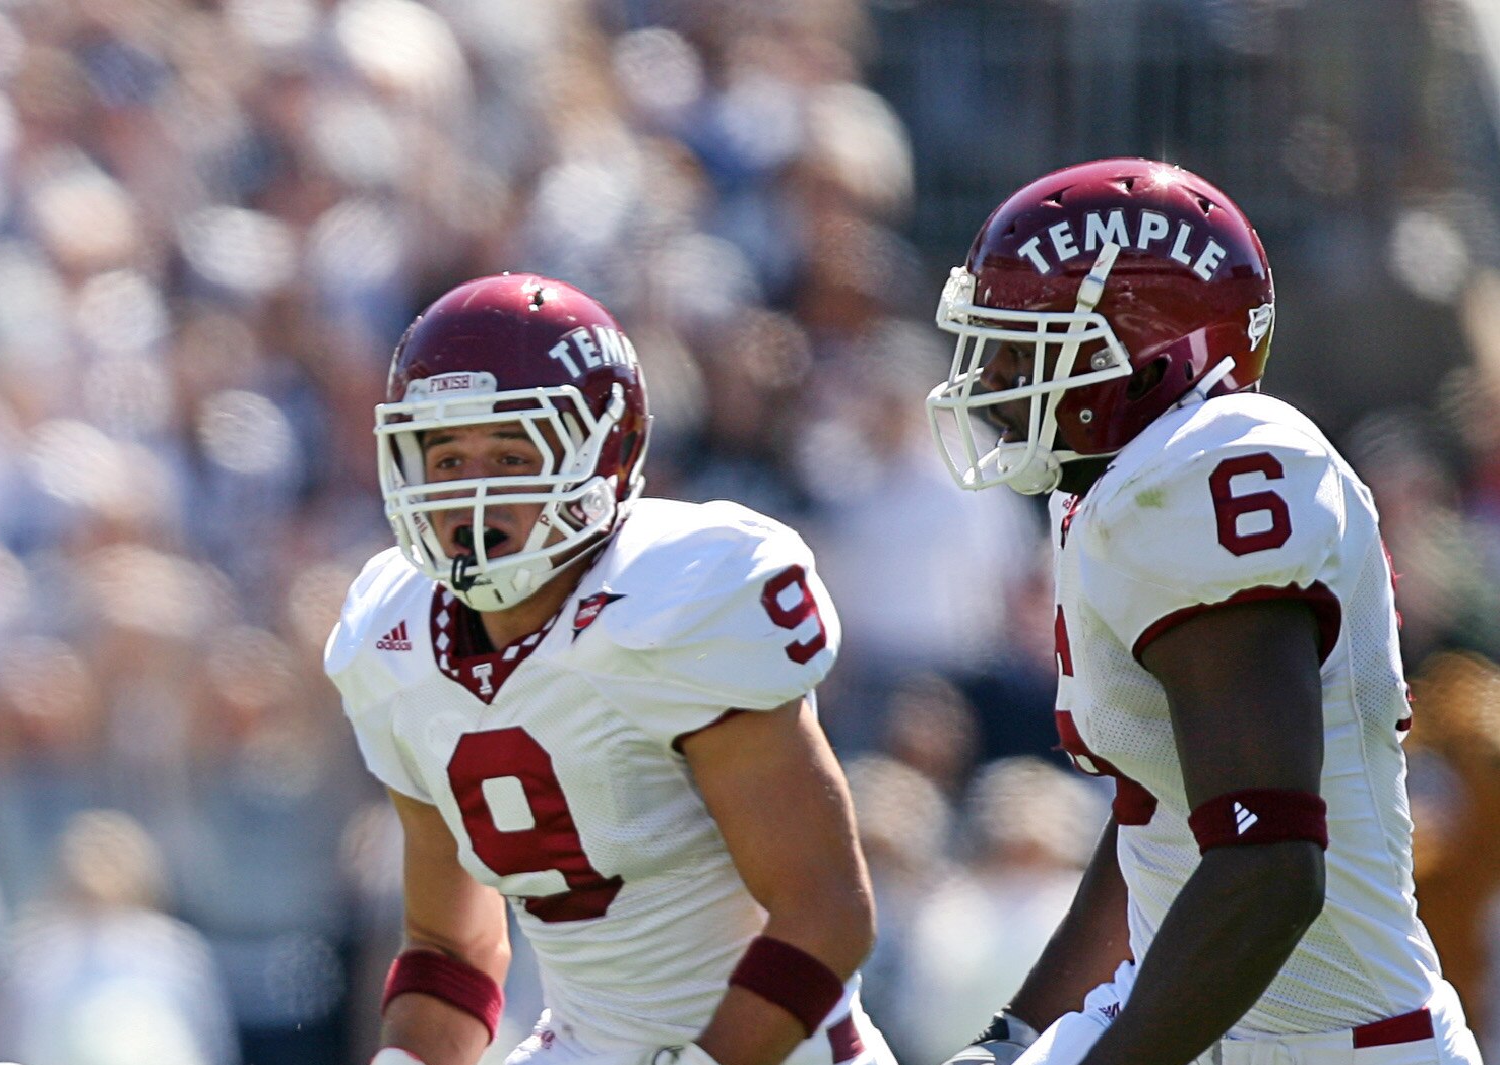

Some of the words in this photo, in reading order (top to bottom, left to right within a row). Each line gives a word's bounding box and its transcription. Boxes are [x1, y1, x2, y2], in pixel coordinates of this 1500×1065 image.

[1017, 210, 1227, 282] TEMPLE
[429, 374, 471, 394] FINISH
[1208, 451, 1293, 557] 6
[376, 640, 413, 651] adidas
[760, 563, 828, 666] 9
[471, 662, 494, 695] T
[446, 725, 626, 924] 9
